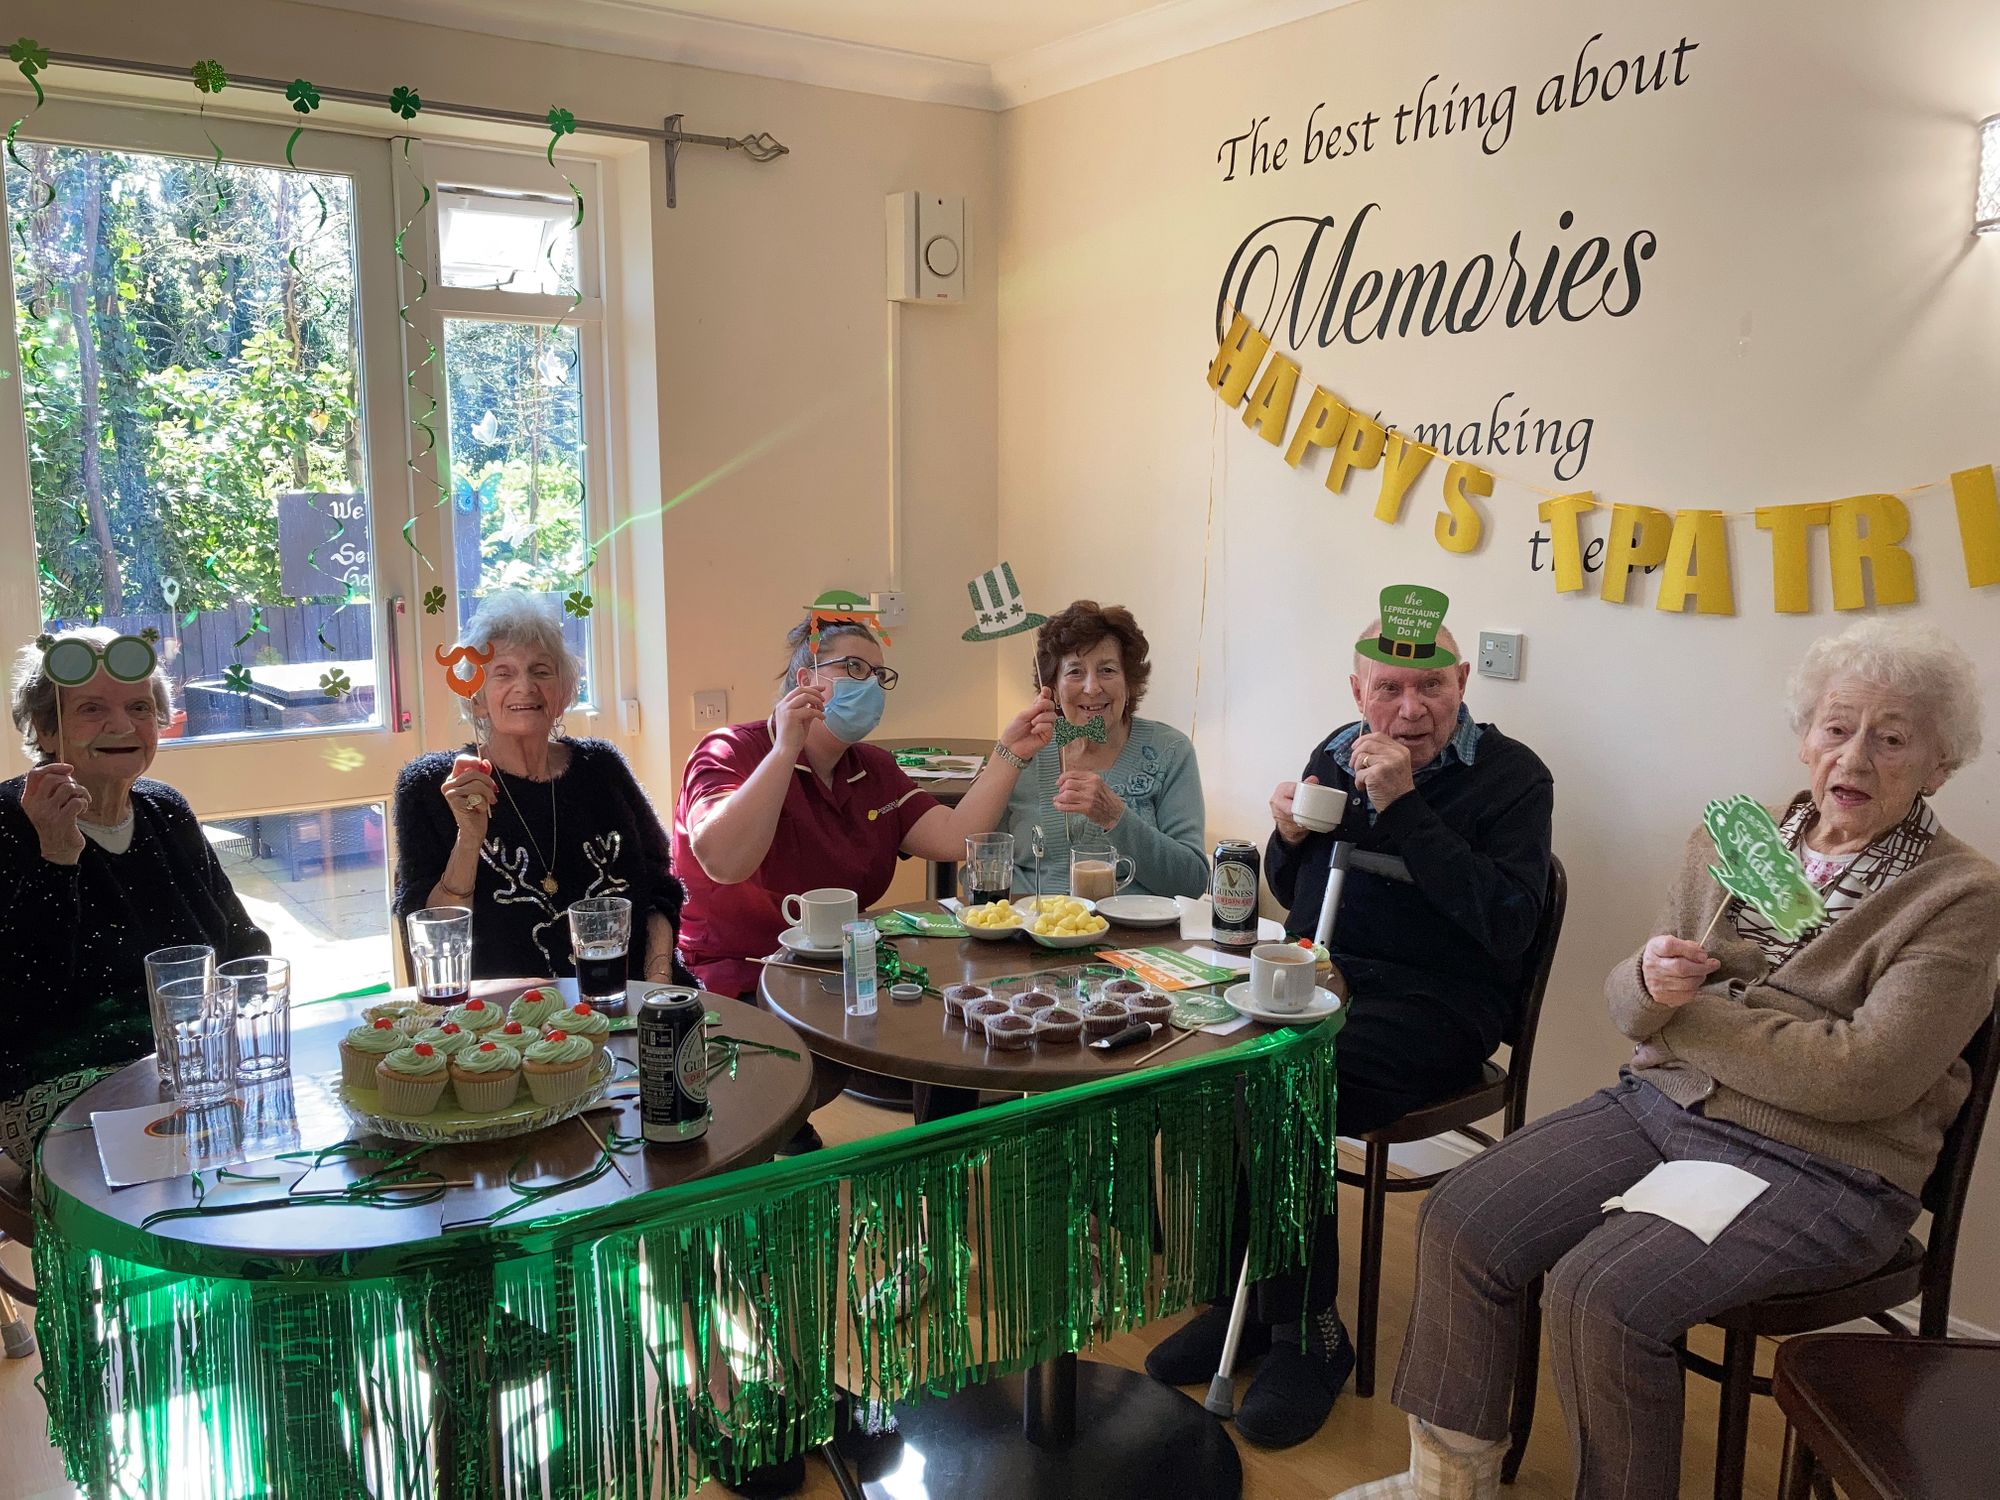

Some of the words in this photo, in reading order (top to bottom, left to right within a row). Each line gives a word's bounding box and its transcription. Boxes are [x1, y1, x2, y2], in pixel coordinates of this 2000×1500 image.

[1216, 116, 1289, 182] The
[1303, 102, 1382, 165] best
[1391, 74, 1518, 156] thing
[1535, 32, 1701, 115] about
[1209, 203, 1658, 365] Memories
[1206, 311, 1438, 525] HAPPY
[1413, 392, 1596, 482] making
[329, 497, 367, 519] We
[1404, 591, 1423, 605] the
[1384, 605, 1440, 618] LEPRECHAUNS
[1388, 615, 1415, 627] Made
[1417, 619, 1432, 628] Me
[1397, 627, 1411, 636] Do
[1413, 629, 1420, 637] It
[1215, 887, 1255, 898] GUINNESS
